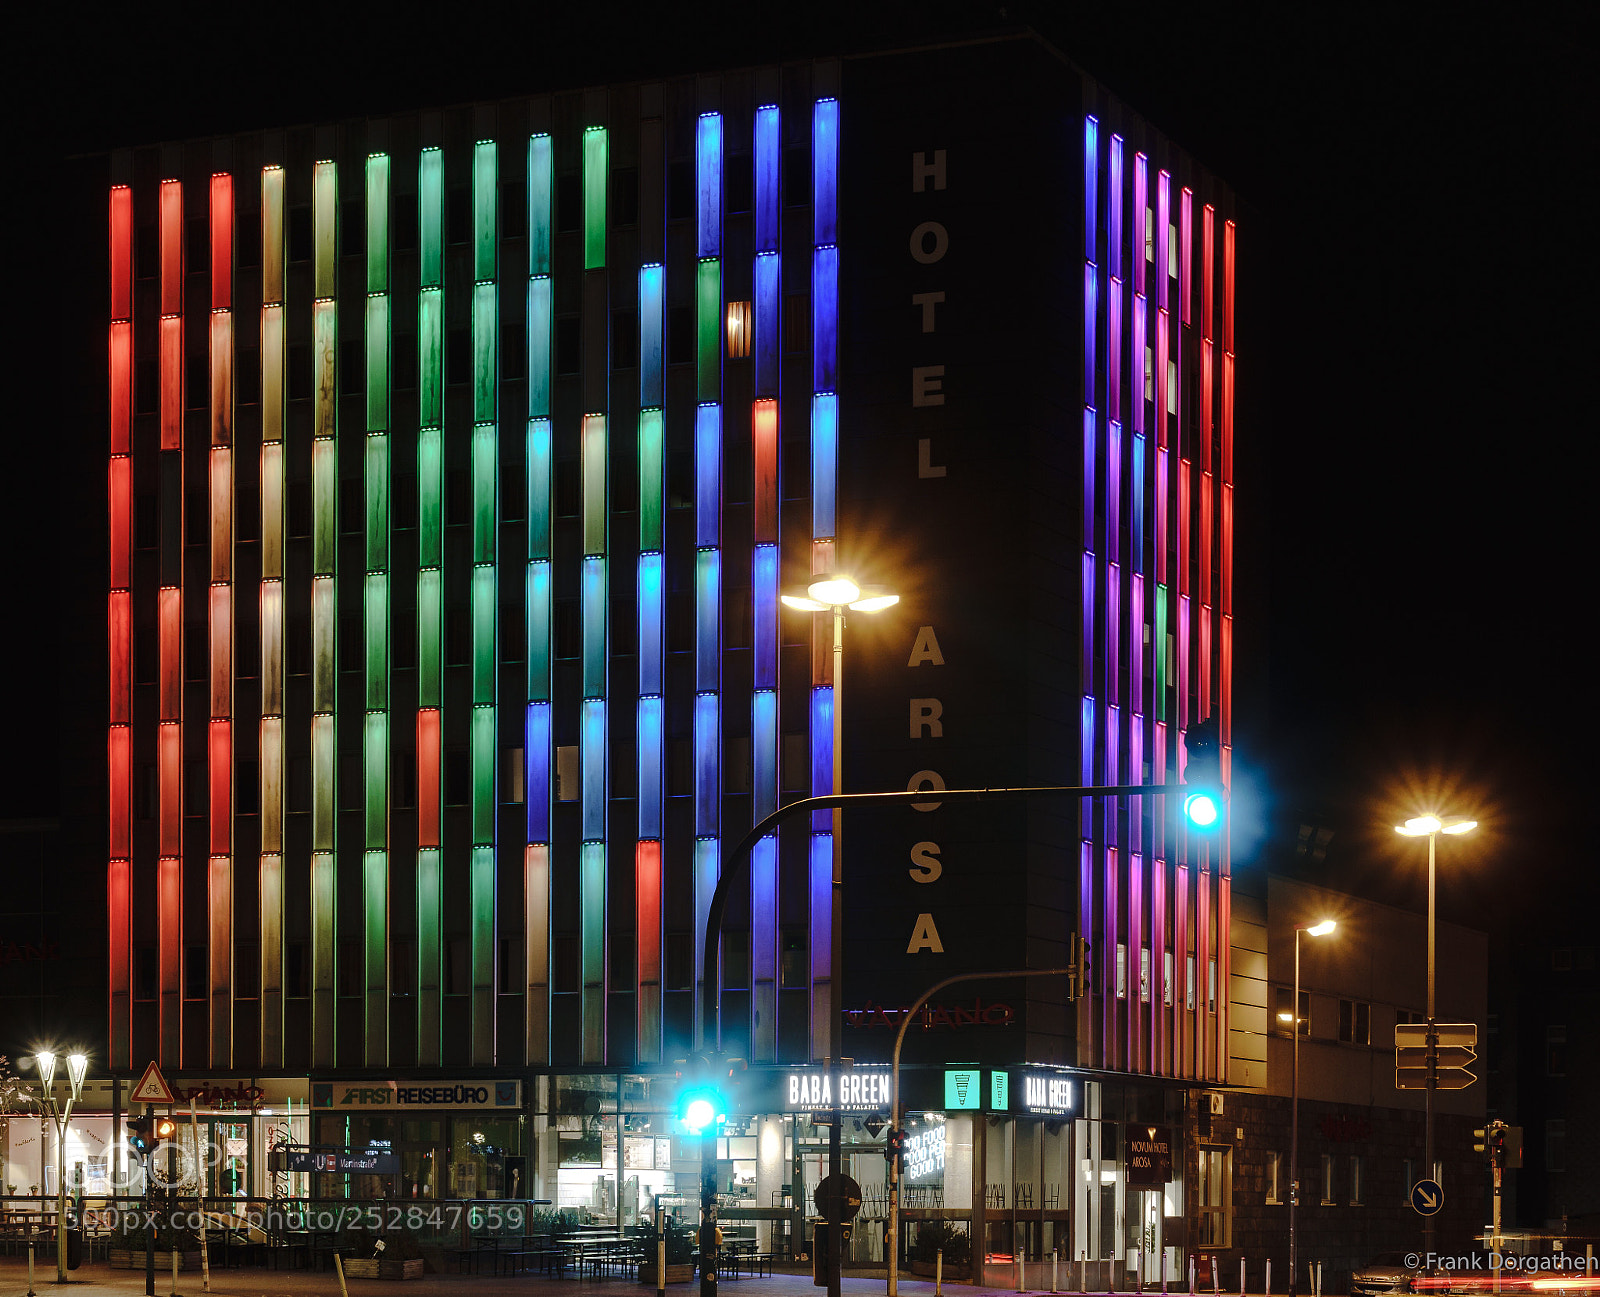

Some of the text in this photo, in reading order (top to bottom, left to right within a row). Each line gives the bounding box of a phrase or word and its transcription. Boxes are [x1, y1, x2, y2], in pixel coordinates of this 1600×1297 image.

[906, 149, 949, 954] HOTEL AROSA
[169, 1081, 265, 1106] APIANO
[341, 1085, 489, 1104] FIRST REISEBÜRO
[789, 1074, 890, 1104] BABA GREEN
[923, 1125, 946, 1147] FOOD
[1131, 1140, 1169, 1154] NOVUM HOTEL
[910, 1159, 934, 1179] GOOD
[1131, 1156, 1152, 1168] AROSA
